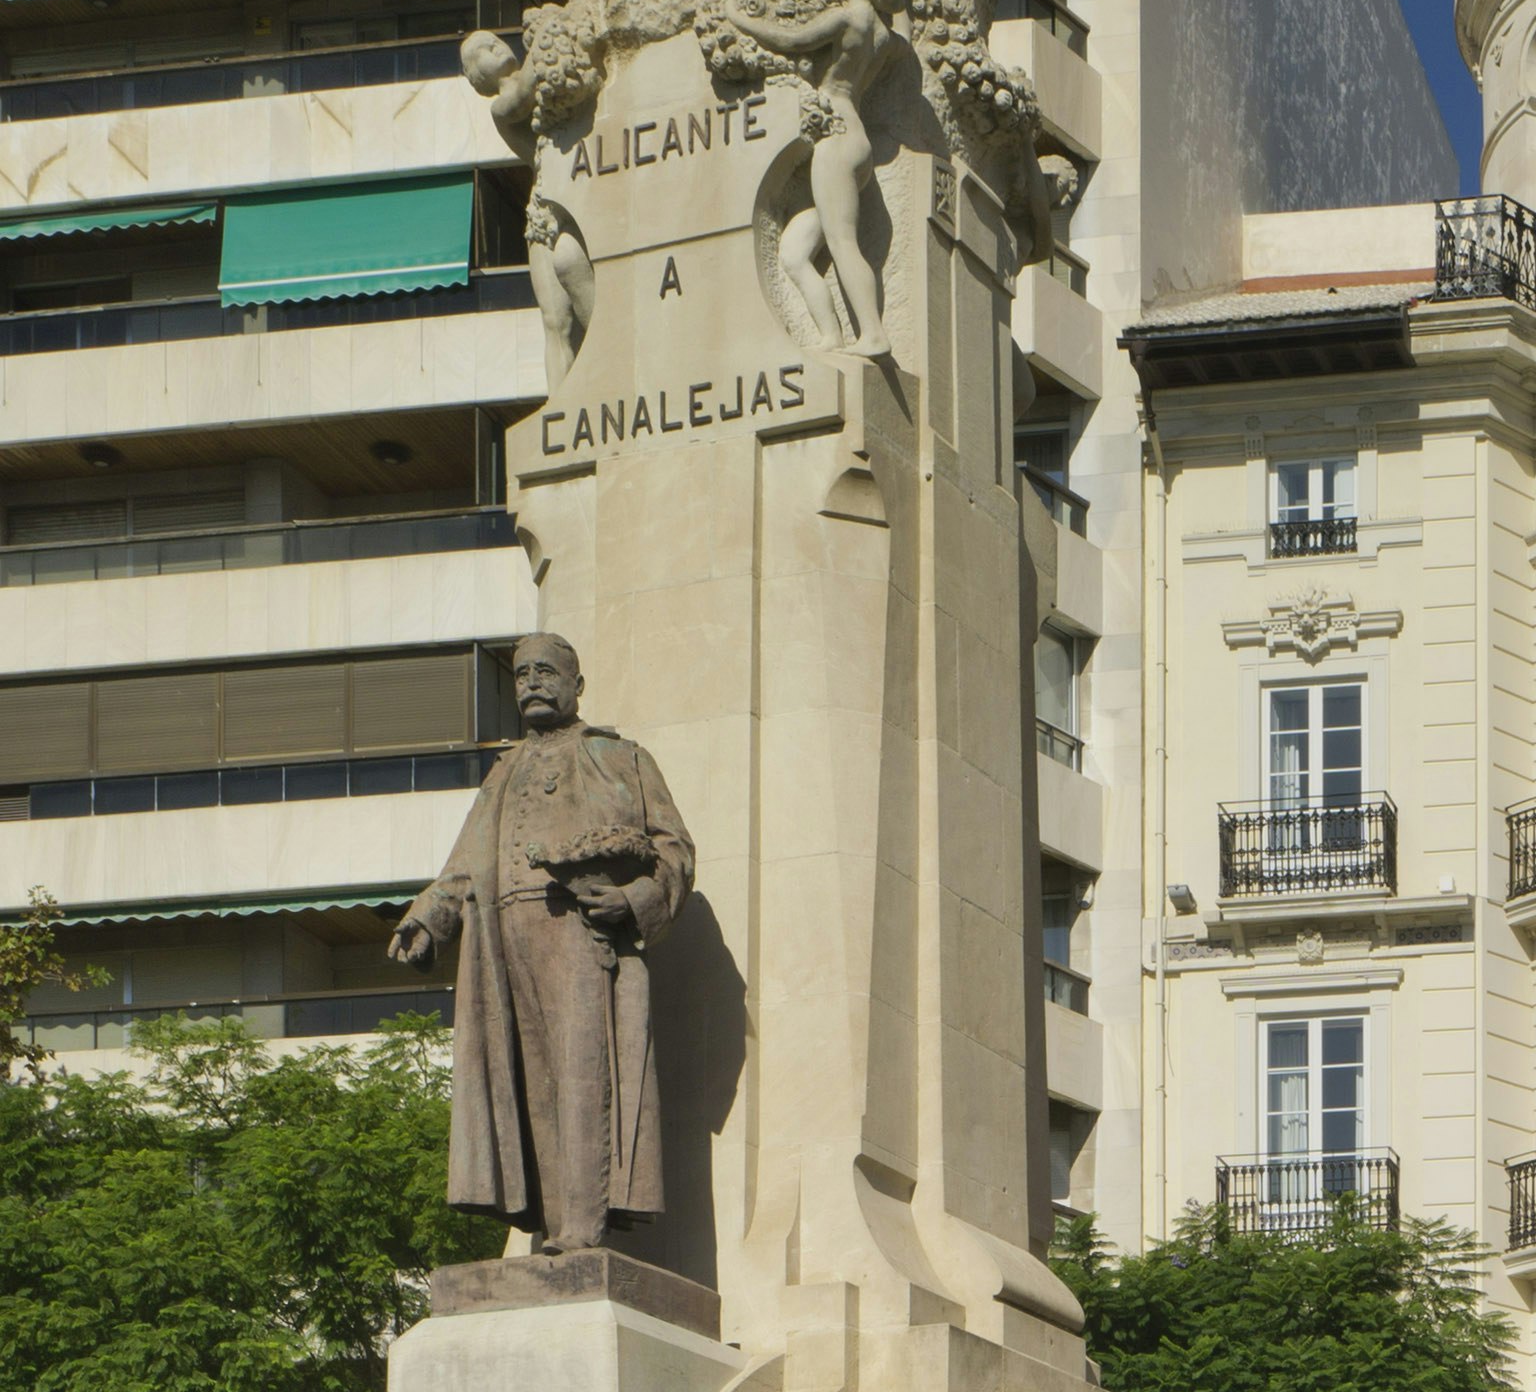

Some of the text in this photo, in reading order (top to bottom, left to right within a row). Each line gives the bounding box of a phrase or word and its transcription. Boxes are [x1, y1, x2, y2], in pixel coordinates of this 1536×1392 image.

[570, 95, 767, 181] ALICANTE
[659, 255, 682, 300] A
[541, 363, 805, 456] CANALEJAS
